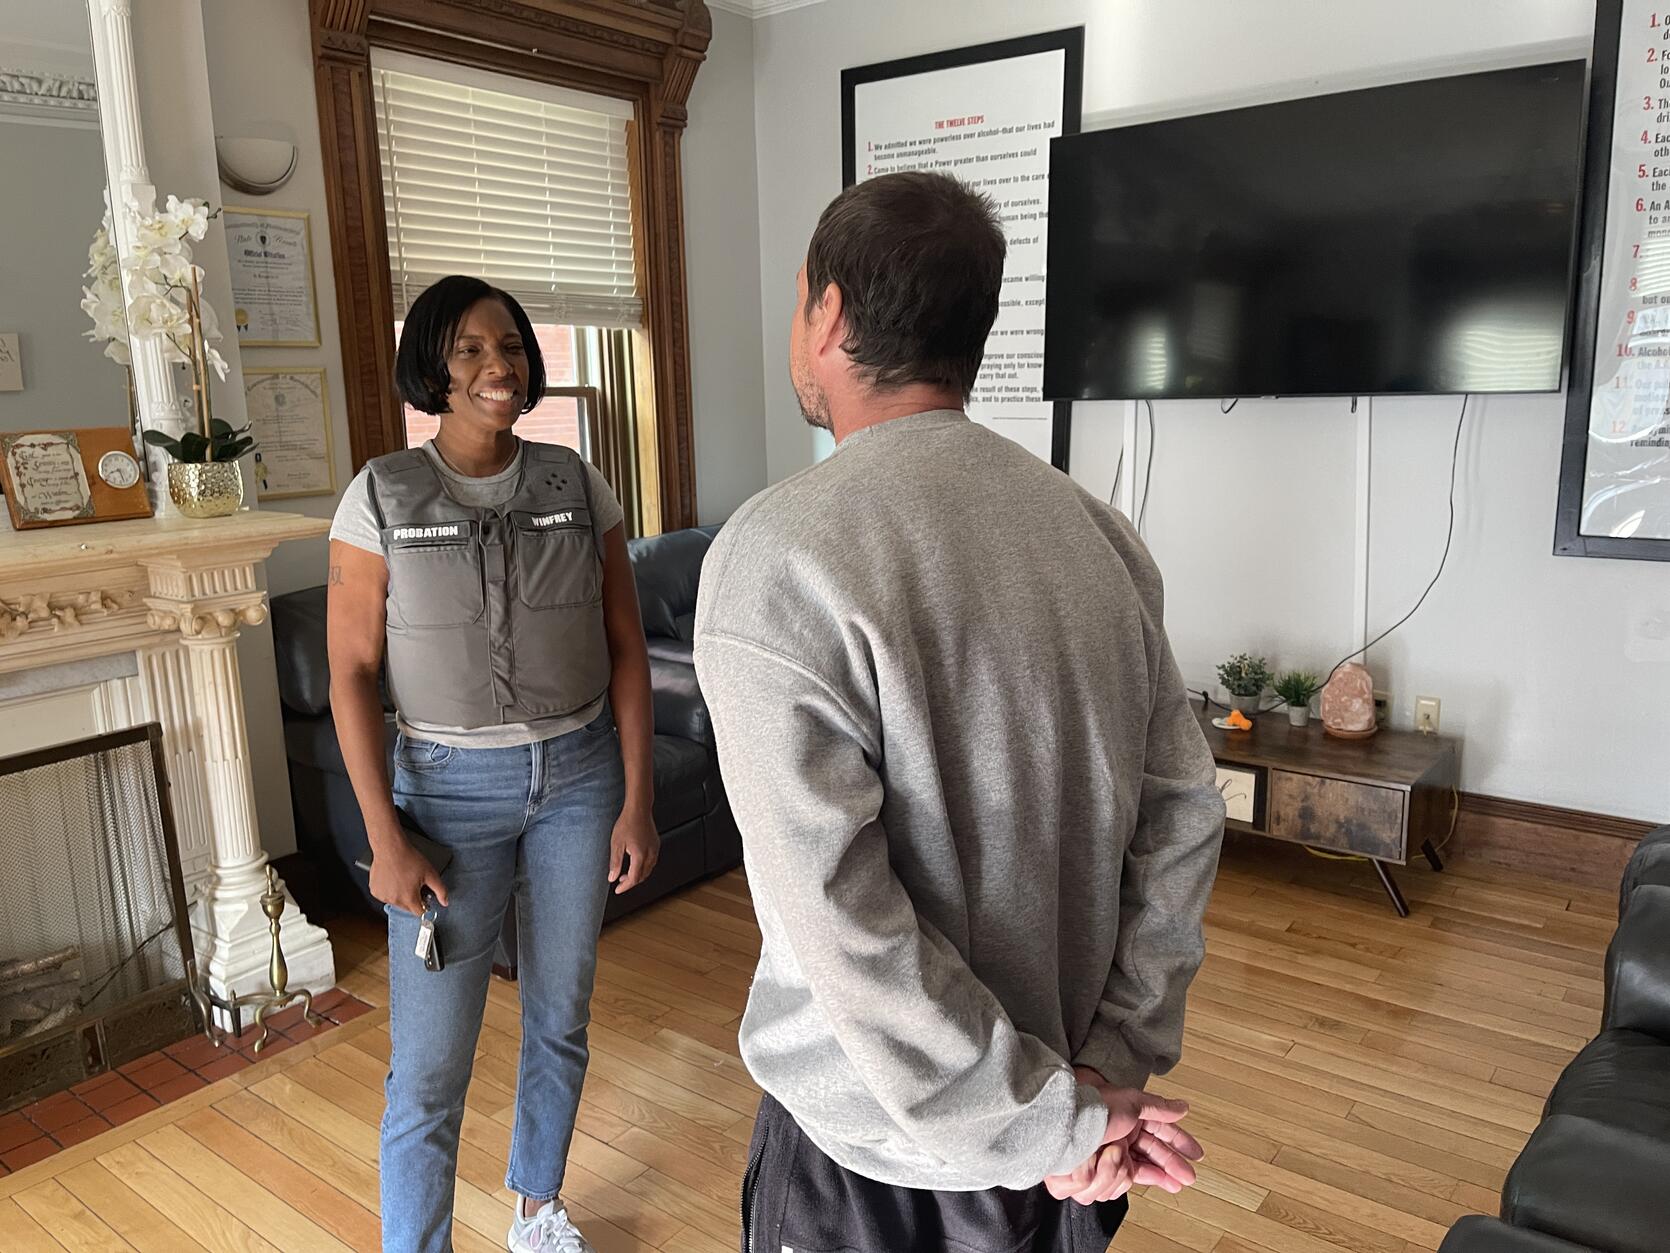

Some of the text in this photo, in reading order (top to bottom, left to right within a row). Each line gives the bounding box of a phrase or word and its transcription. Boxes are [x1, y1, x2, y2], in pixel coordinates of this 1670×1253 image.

[1650, 13, 1660, 28] 1.
[1647, 48, 1657, 62] 2.
[1643, 96, 1654, 110] 3.
[934, 115, 984, 130] THE TWELVE STEPS
[884, 140, 908, 150] admitted
[933, 134, 962, 144] powerless
[963, 132, 976, 140] over
[1044, 120, 1055, 129] had
[1641, 130, 1651, 144] 4.
[874, 152, 894, 160] become
[897, 163, 916, 171] believe
[934, 159, 952, 168] Power
[954, 157, 974, 167] greater
[976, 154, 988, 162] than
[990, 151, 1018, 161] ourselves
[1020, 148, 1037, 158] could
[1638, 164, 1649, 178] 5.
[982, 178, 996, 186] lives
[1020, 174, 1030, 182] the
[1652, 180, 1667, 191] the
[1636, 198, 1646, 212] 6.
[1650, 200, 1661, 211] An
[1020, 212, 1036, 221] being
[1649, 215, 1658, 224] to
[1010, 236, 1038, 246] defects of
[1025, 274, 1045, 282] willing
[1025, 298, 1044, 307] except
[1004, 362, 1016, 370] only
[394, 526, 458, 540] PROBATION
